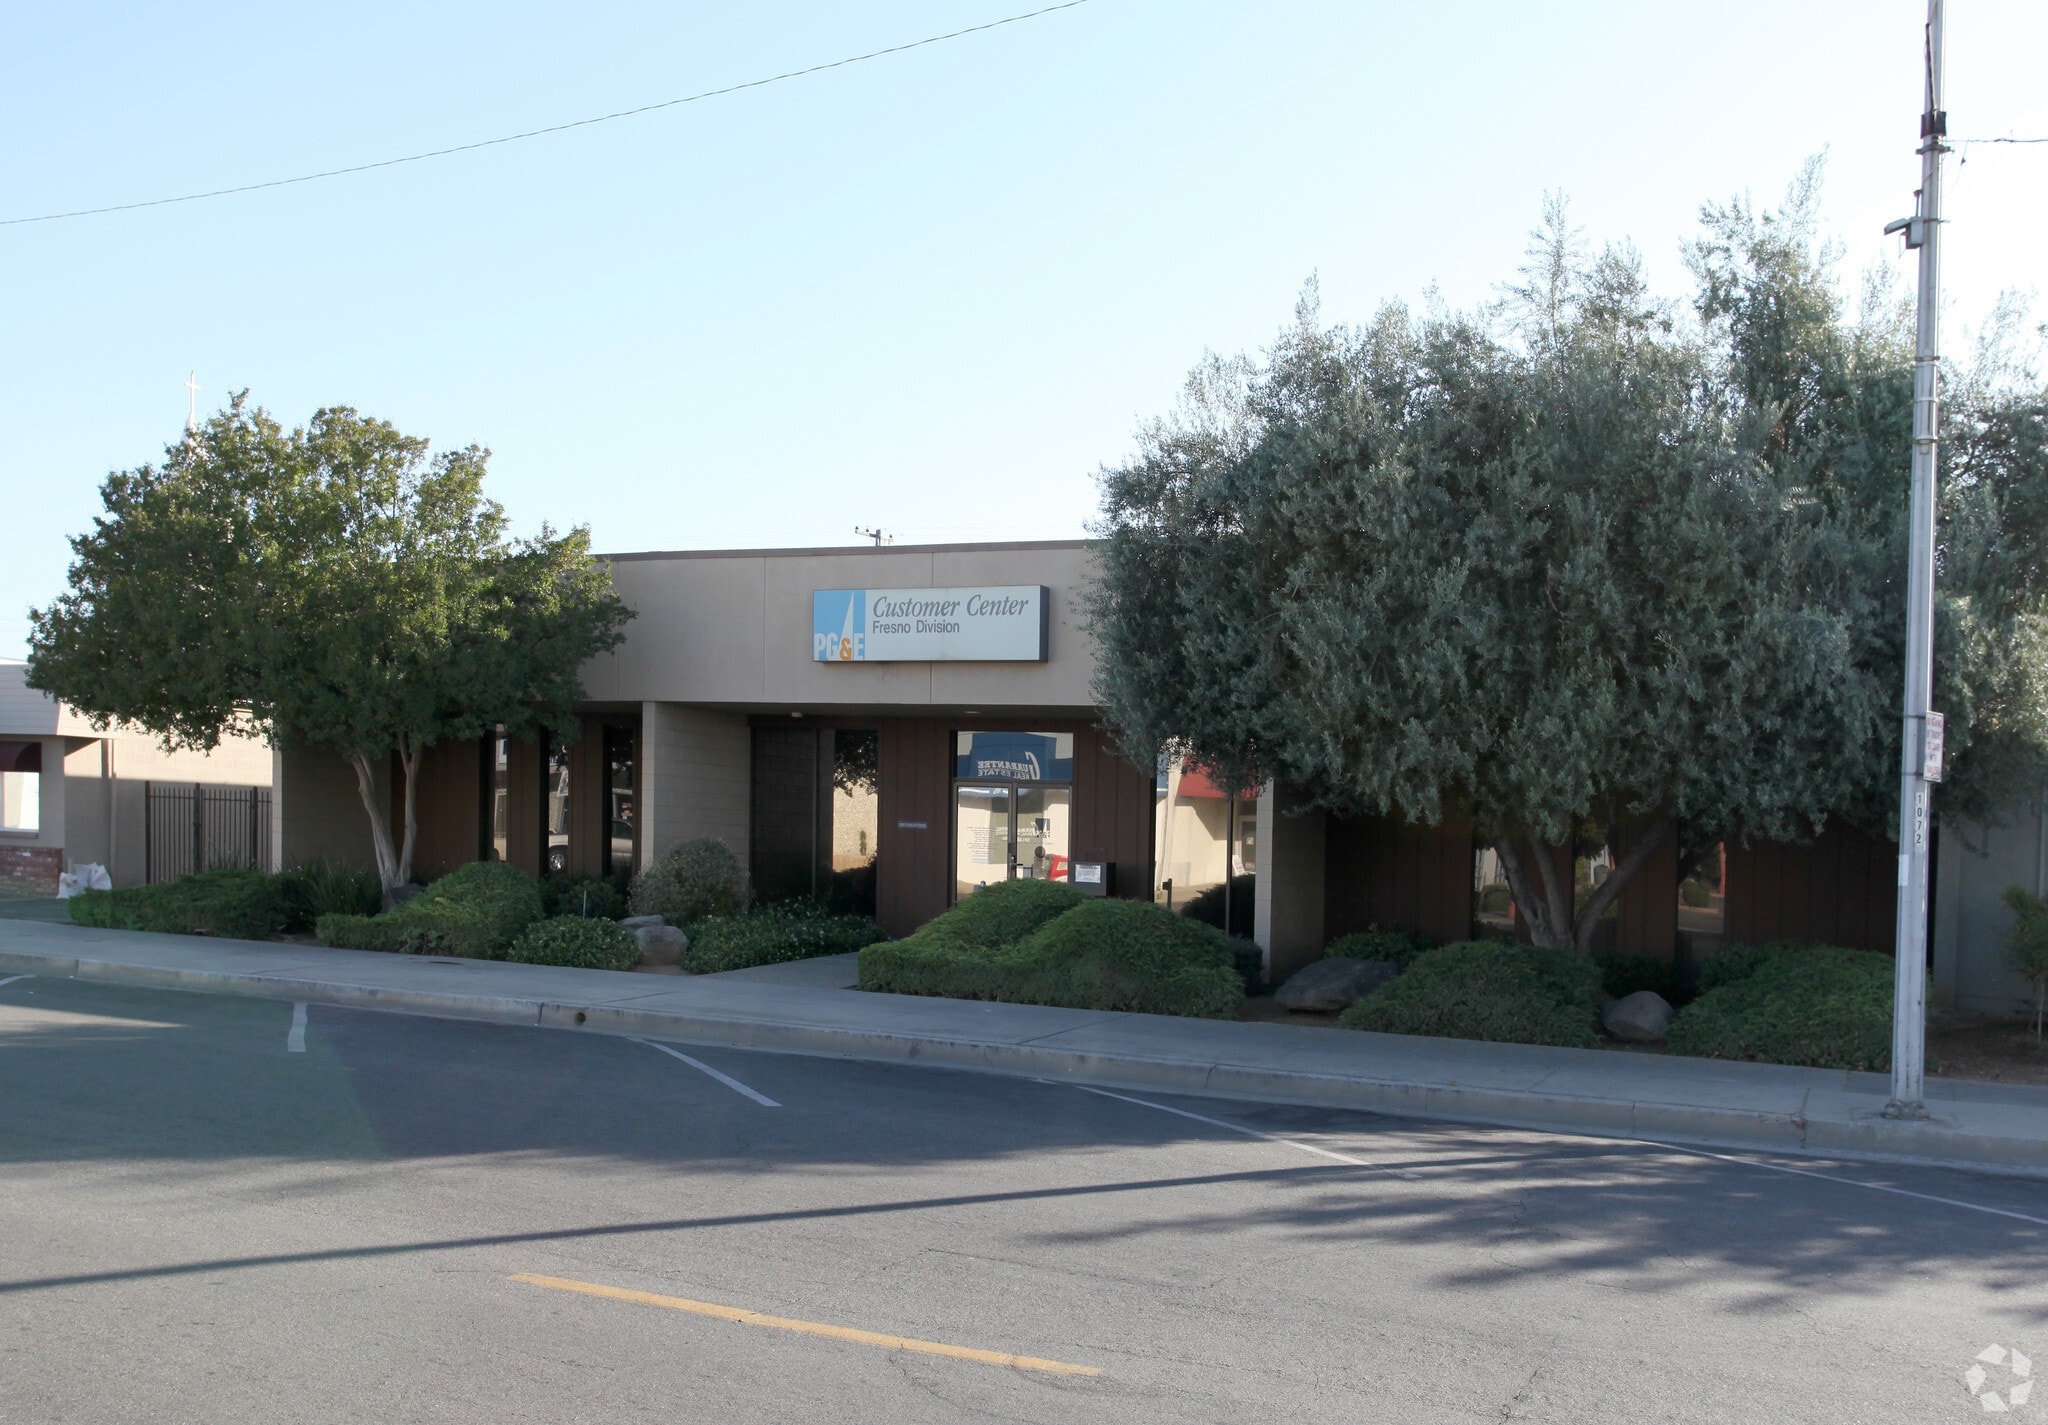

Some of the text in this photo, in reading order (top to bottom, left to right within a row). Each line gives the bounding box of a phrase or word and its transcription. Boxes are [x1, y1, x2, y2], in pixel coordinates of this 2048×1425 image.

[873, 594, 1030, 618] Customer Center
[872, 619, 960, 634] Fresno Division
[815, 632, 865, 661] PG&E
